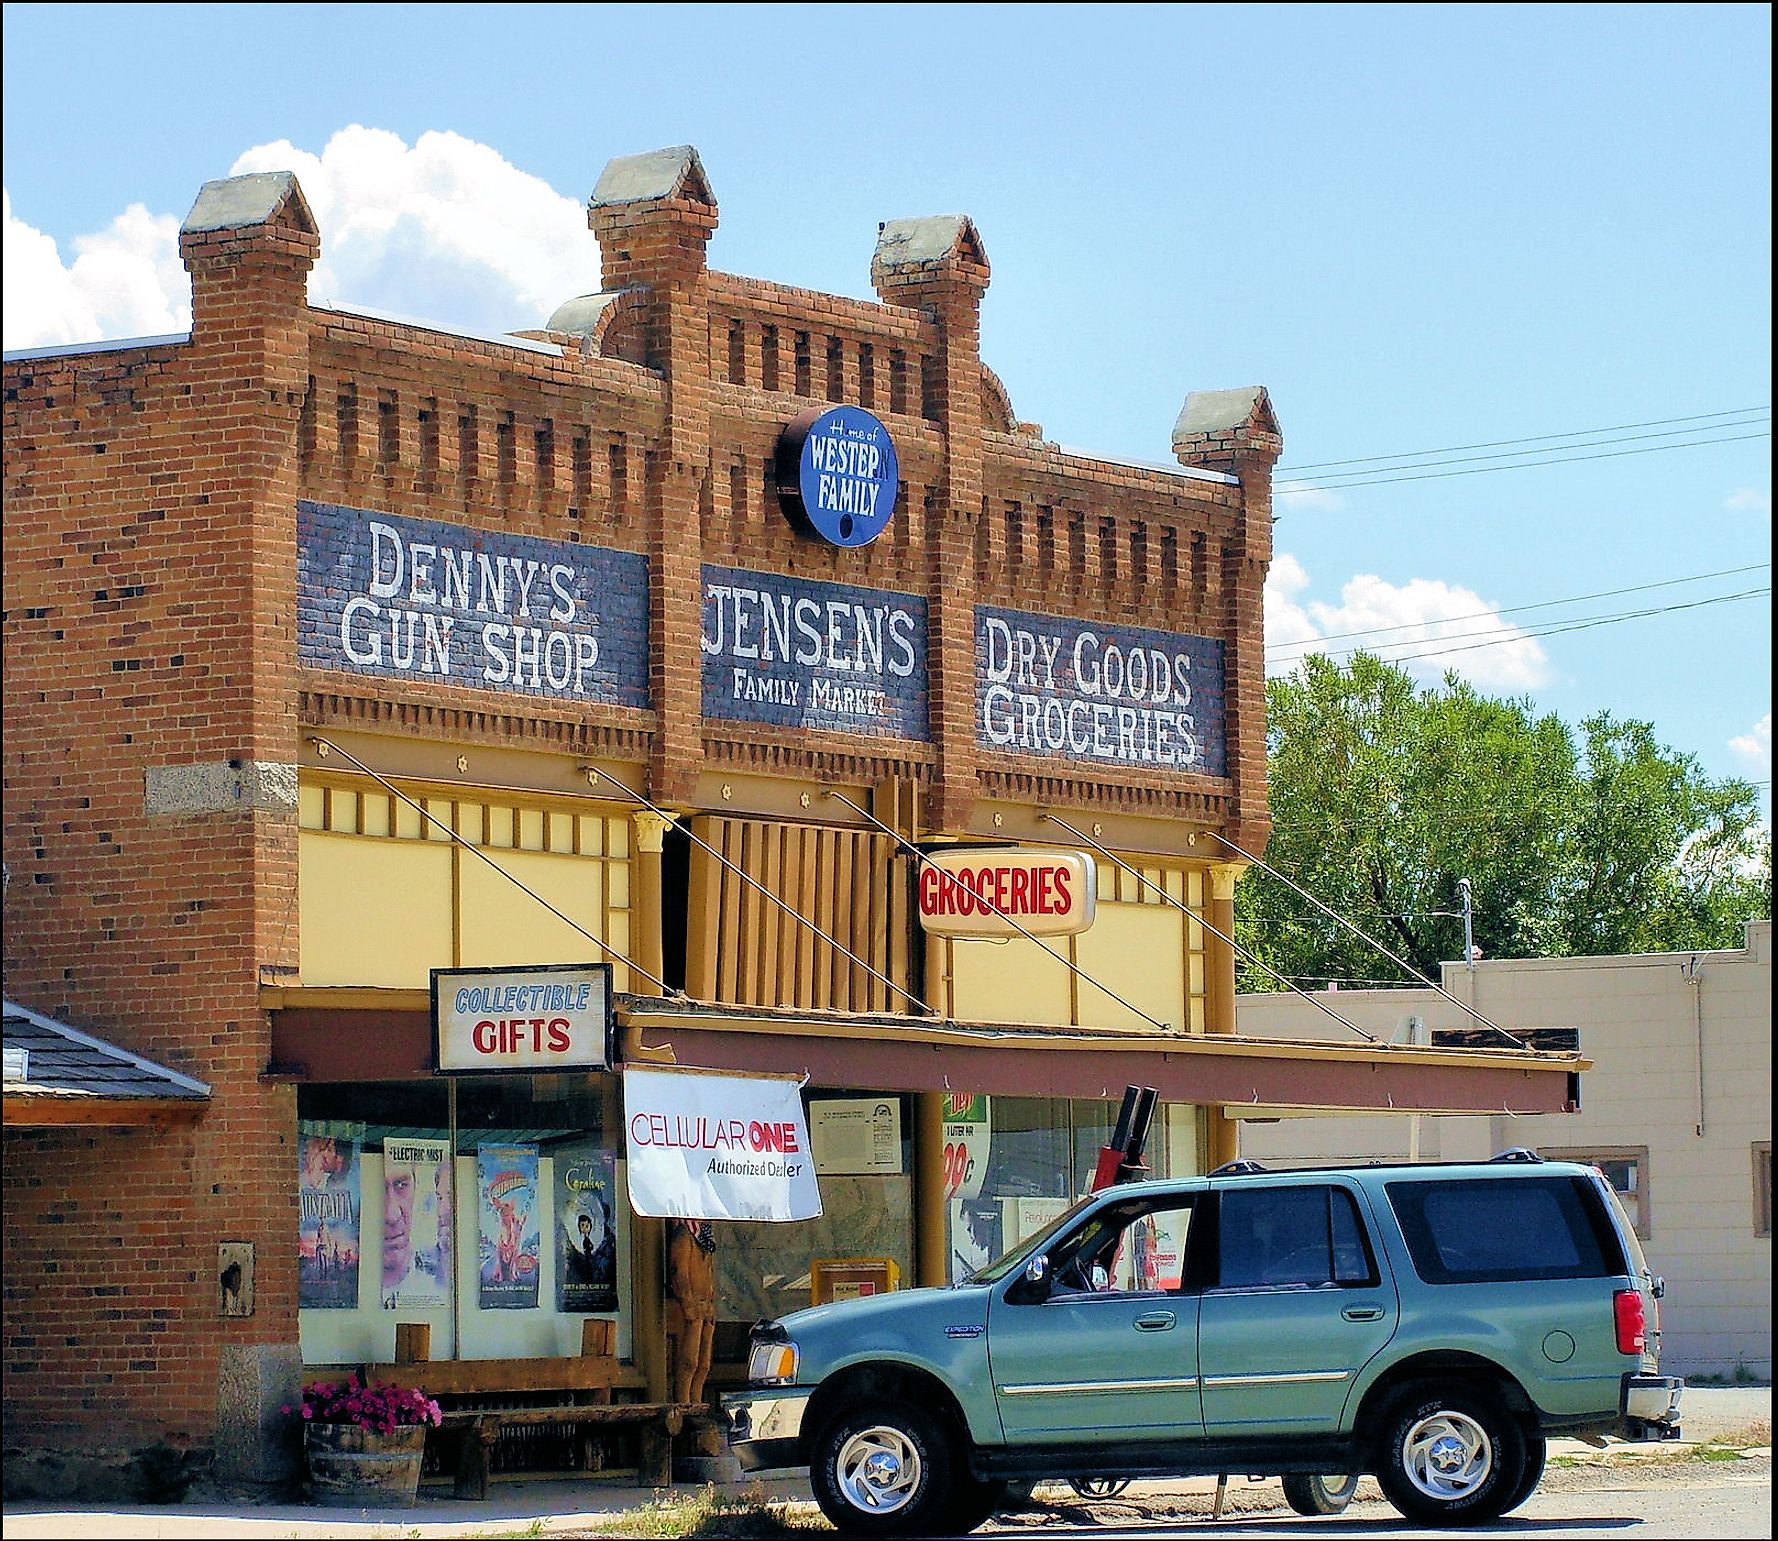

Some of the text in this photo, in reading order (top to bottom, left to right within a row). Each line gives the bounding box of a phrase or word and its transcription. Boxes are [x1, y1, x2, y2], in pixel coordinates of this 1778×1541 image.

[829, 419, 879, 442] Hme of
[817, 473, 880, 518] FAMILY
[369, 520, 577, 624] DENNY'S
[341, 597, 600, 693] GUN SHOP
[700, 583, 916, 677] JENSEN'S
[985, 617, 1192, 707] DRY GOODS
[733, 668, 887, 717] FAMILY MARKET
[984, 684, 1197, 765] GROCERIES
[920, 866, 1072, 917] GROCERIES
[455, 983, 591, 1014] COLLECTIBLE
[472, 1017, 571, 1054] GIFTS
[706, 1157, 802, 1178] Authorized Dealer
